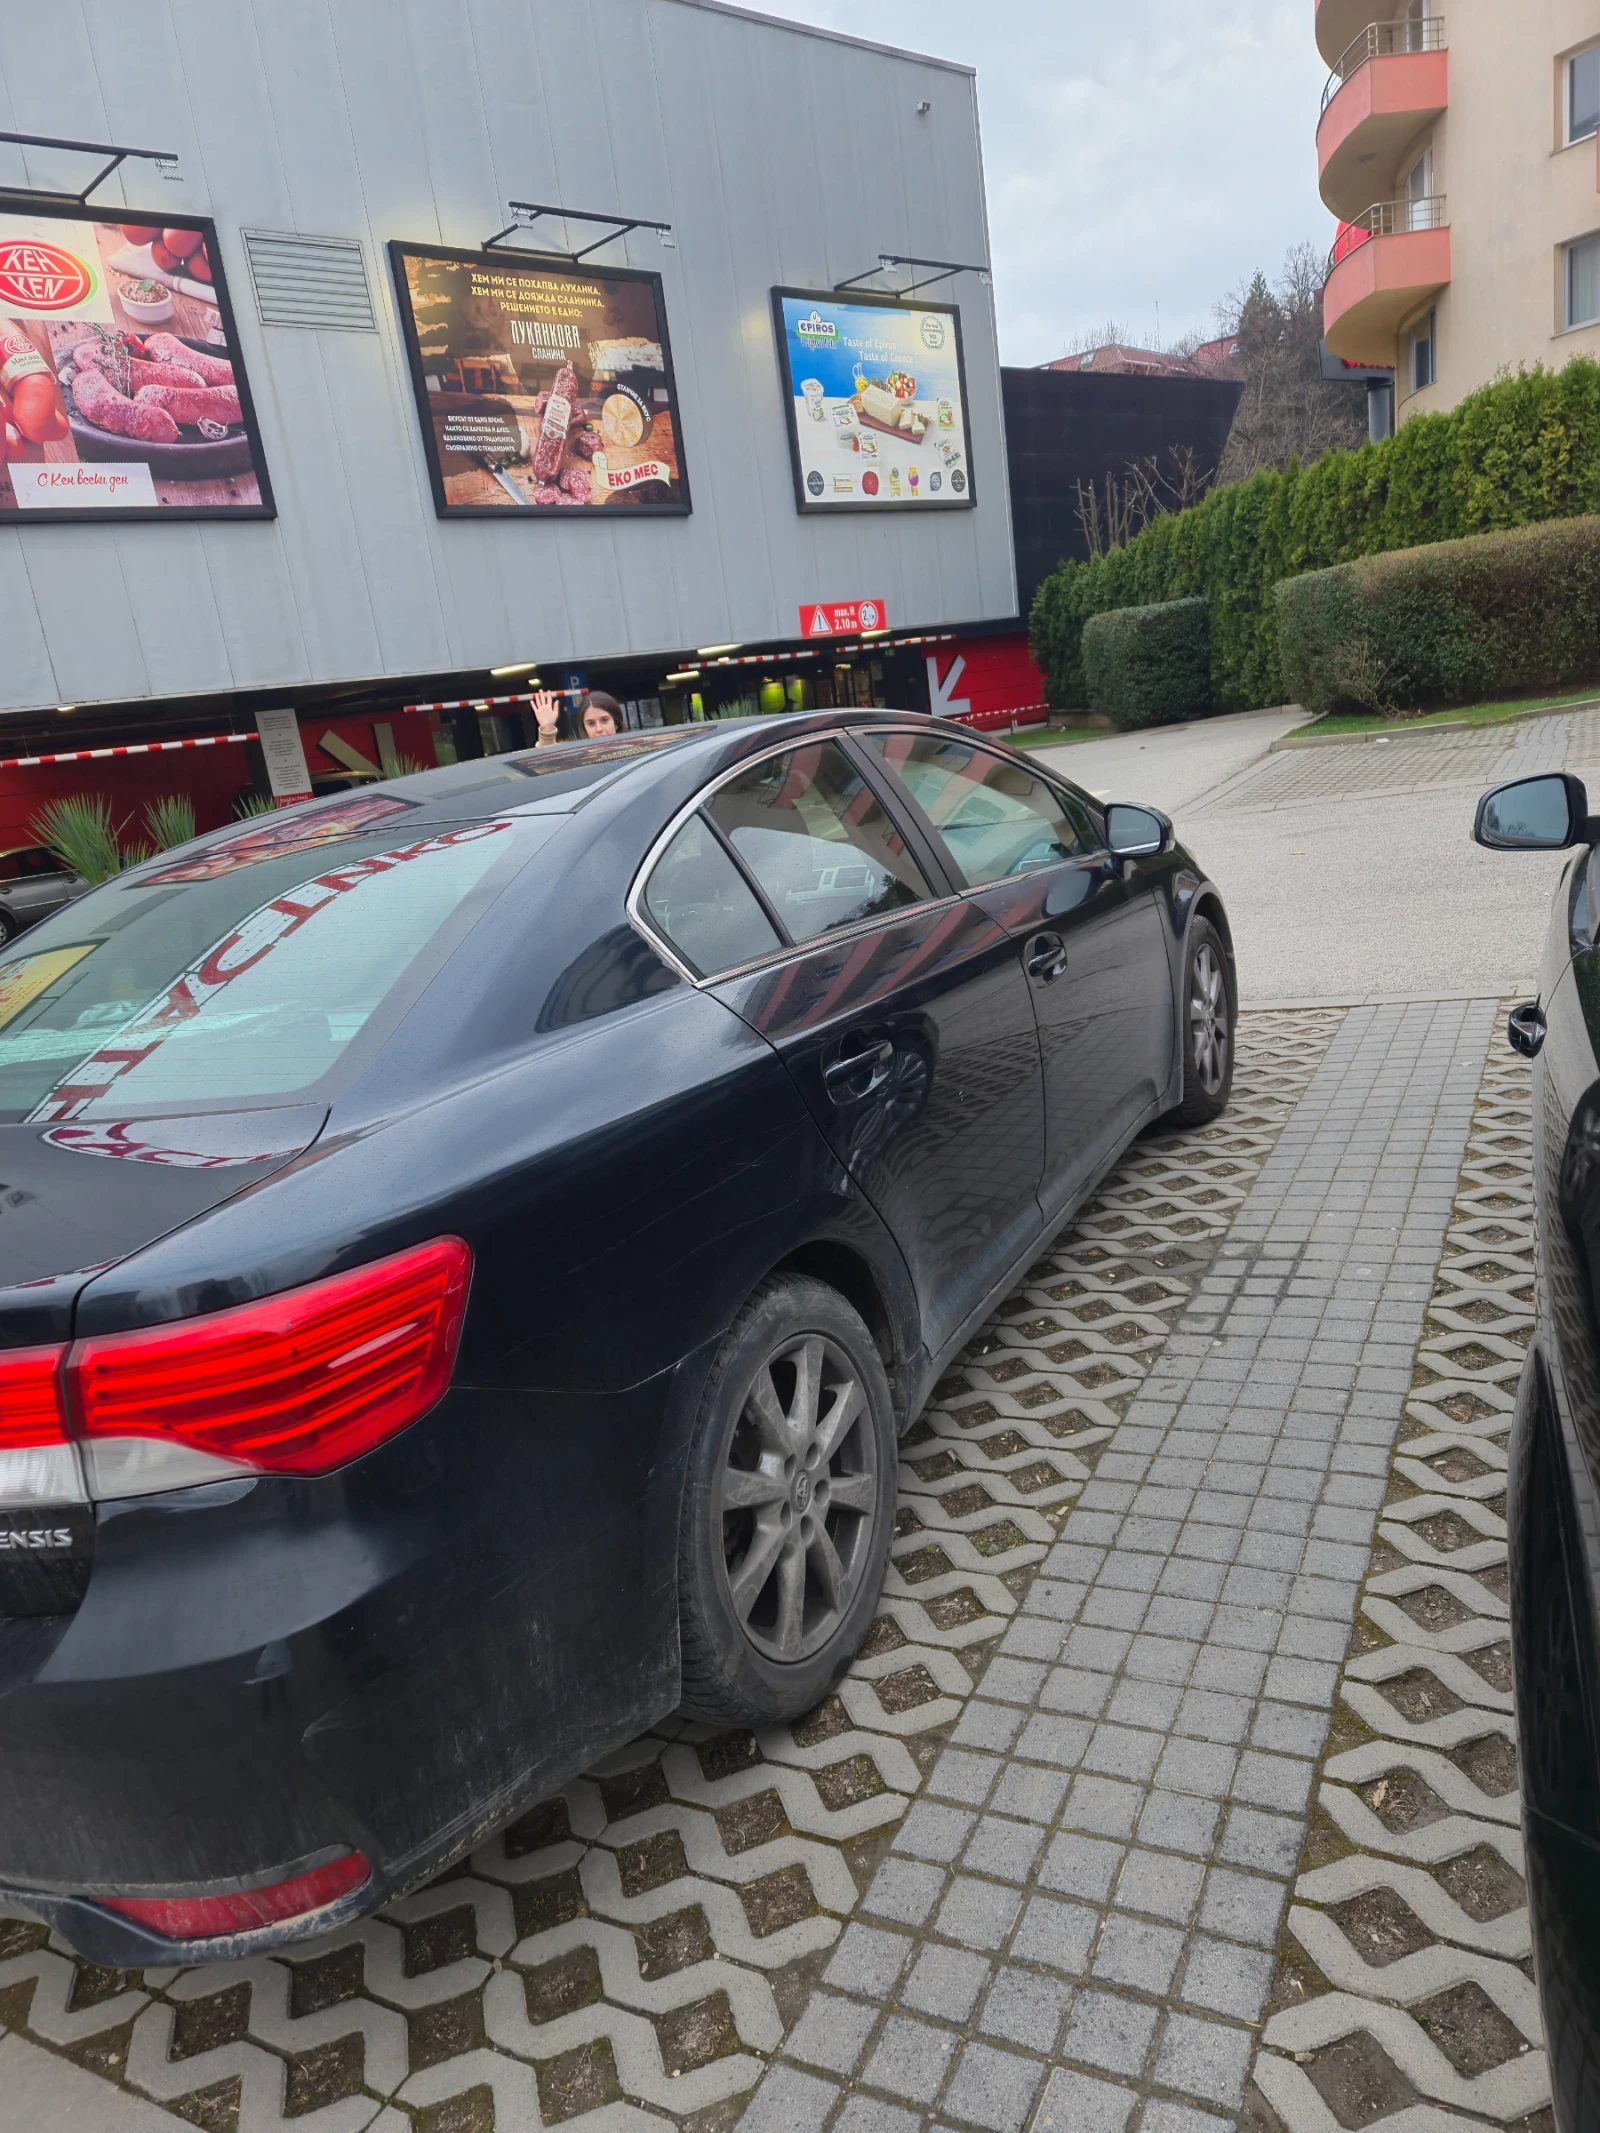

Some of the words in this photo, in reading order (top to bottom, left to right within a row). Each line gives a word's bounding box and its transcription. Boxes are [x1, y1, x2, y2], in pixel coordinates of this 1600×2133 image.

[471, 273, 490, 285] ХЕМ
[490, 275, 505, 286] МИ
[506, 277, 518, 287] СЕ
[518, 278, 559, 292] ПОХАПВА
[471, 286, 490, 297] ХЕМ
[490, 288, 505, 298] МИ
[506, 289, 518, 299] СЕ
[518, 291, 557, 304] ДОЯЖДА
[500, 302, 551, 315] РЕШЕНИЕТО
[551, 306, 557, 316] Е
[510, 320, 581, 349] ЛУКАНКОВА
[800, 323, 834, 333] EPIROS
[842, 337, 864, 348] Taste
[865, 338, 873, 348] of
[532, 347, 566, 361] СЛАНИНА
[858, 350, 879, 362] Taste
[881, 351, 888, 362] of
[889, 353, 914, 364] Greece
[37, 472, 48, 487] С
[50, 473, 75, 487] Кен
[77, 468, 108, 486] всеки
[109, 475, 129, 493] ден
[607, 471, 632, 488] ЕКО
[634, 463, 659, 480] МЕС
[835, 618, 851, 630] 2.10
